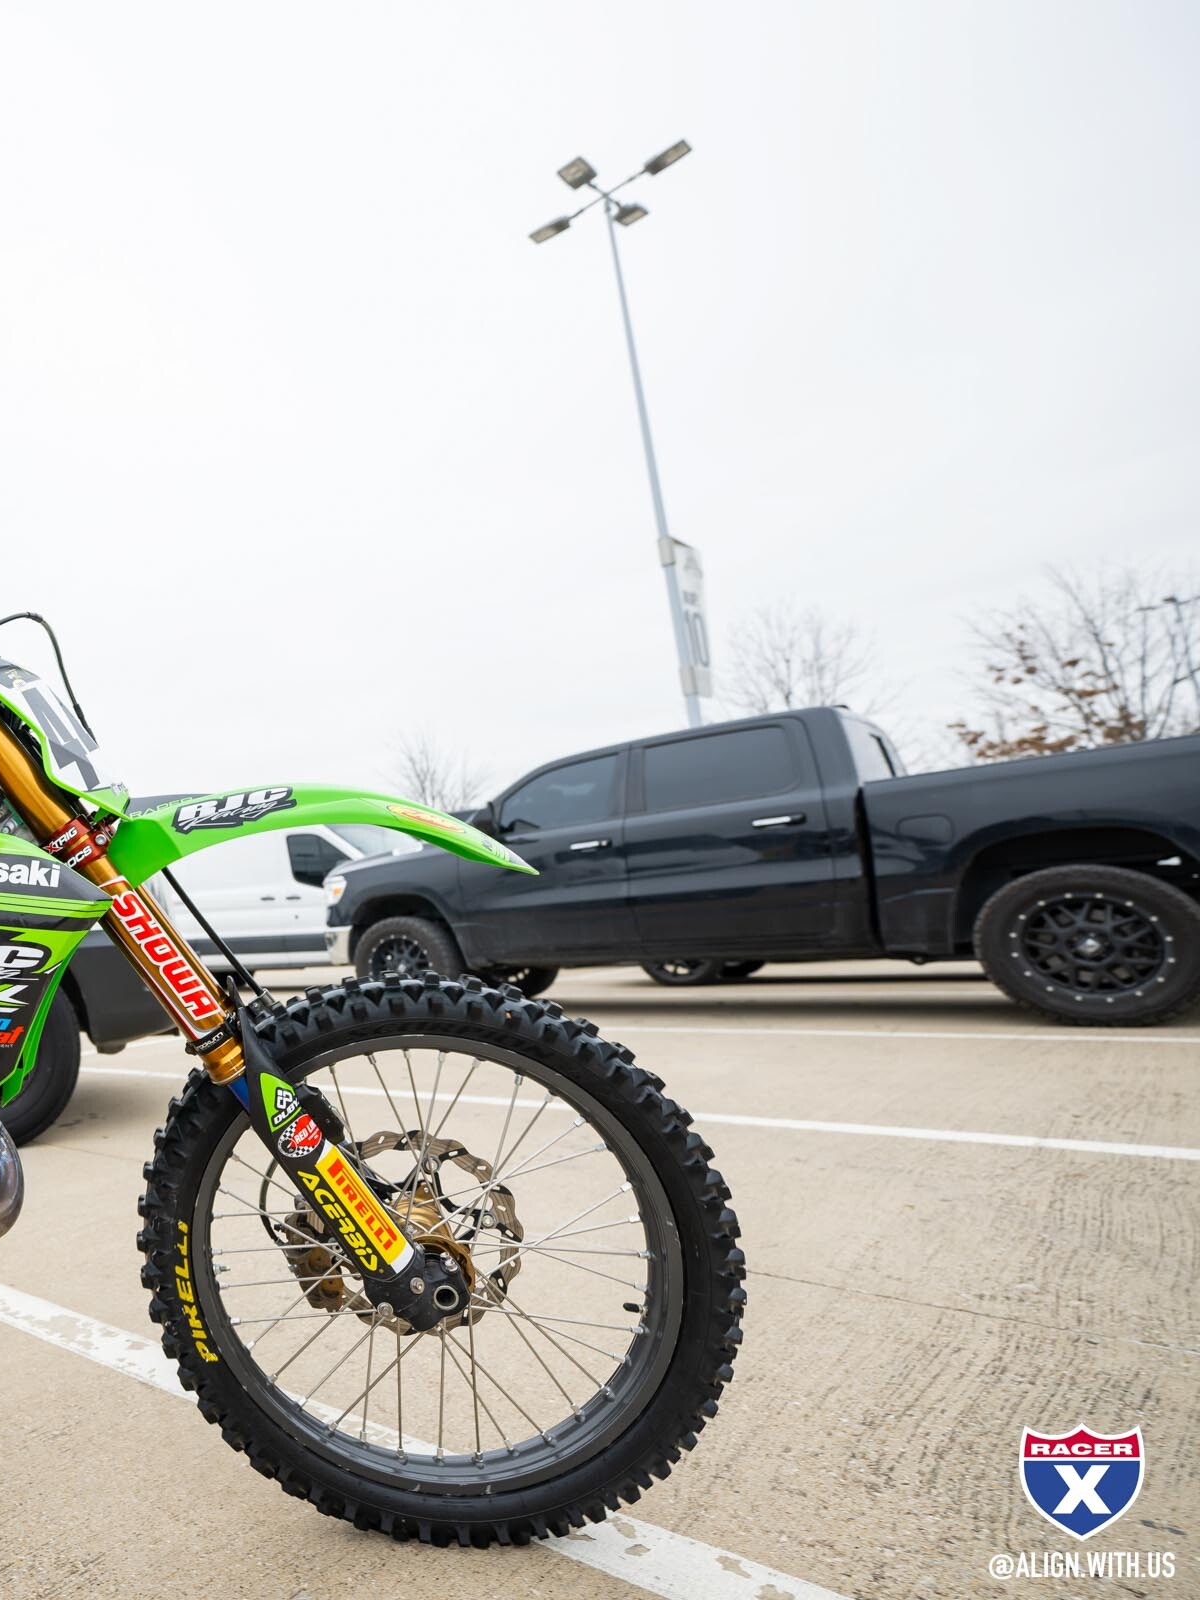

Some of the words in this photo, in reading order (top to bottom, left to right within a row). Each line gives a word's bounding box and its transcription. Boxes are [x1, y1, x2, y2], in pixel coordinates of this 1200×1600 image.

[43, 826, 78, 854] XTRIG
[64, 846, 93, 868] OCS
[111, 890, 221, 1020] SHOWA
[294, 1127, 309, 1145] RED
[327, 1158, 397, 1251] PIRELLI
[174, 1219, 220, 1363] PIRELLI
